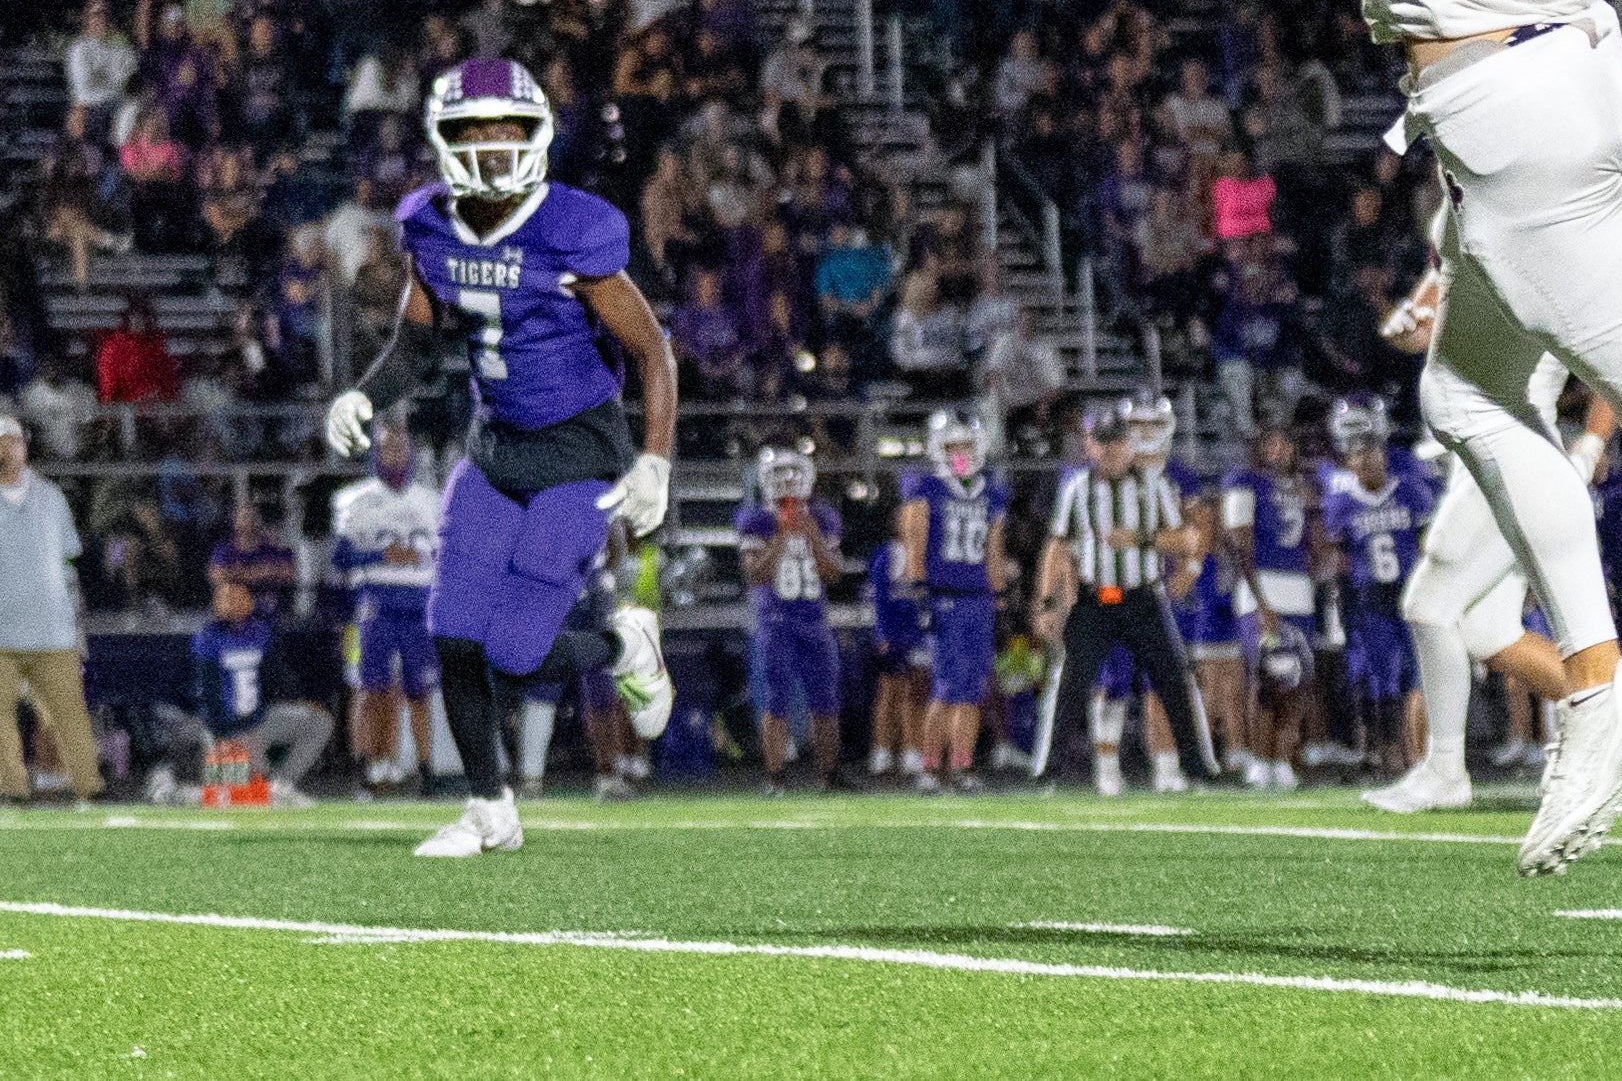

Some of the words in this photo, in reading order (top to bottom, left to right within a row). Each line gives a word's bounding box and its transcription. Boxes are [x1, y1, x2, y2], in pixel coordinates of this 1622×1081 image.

[446, 256, 521, 289] TIGERS
[459, 289, 508, 380] 7
[944, 517, 988, 563] 10
[1370, 533, 1400, 582] 6
